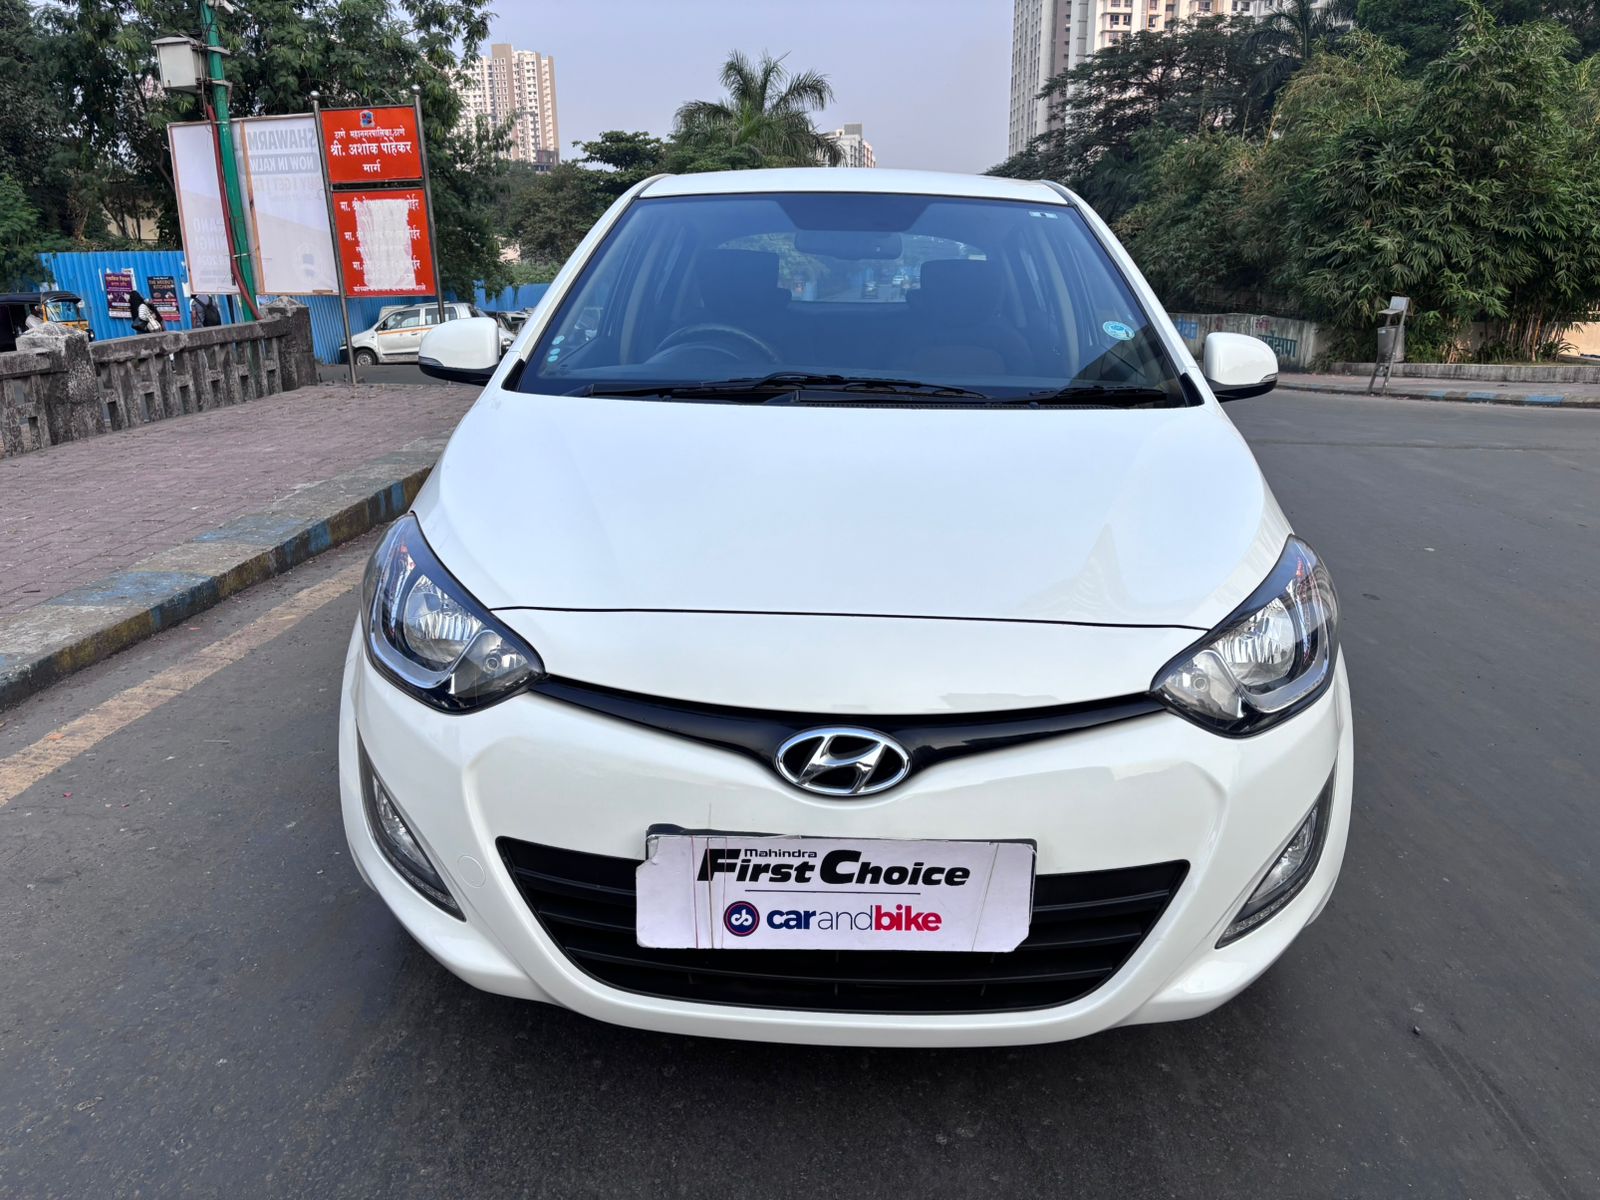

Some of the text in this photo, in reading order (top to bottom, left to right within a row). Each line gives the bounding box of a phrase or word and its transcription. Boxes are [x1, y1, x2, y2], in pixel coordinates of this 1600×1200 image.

[349, 138, 379, 155] अशोक
[380, 137, 412, 156] पोहेकर
[362, 159, 381, 172] मार्ग
[744, 848, 818, 858] Mahindra
[697, 848, 971, 887] First Choice
[767, 904, 942, 932] carandbike
